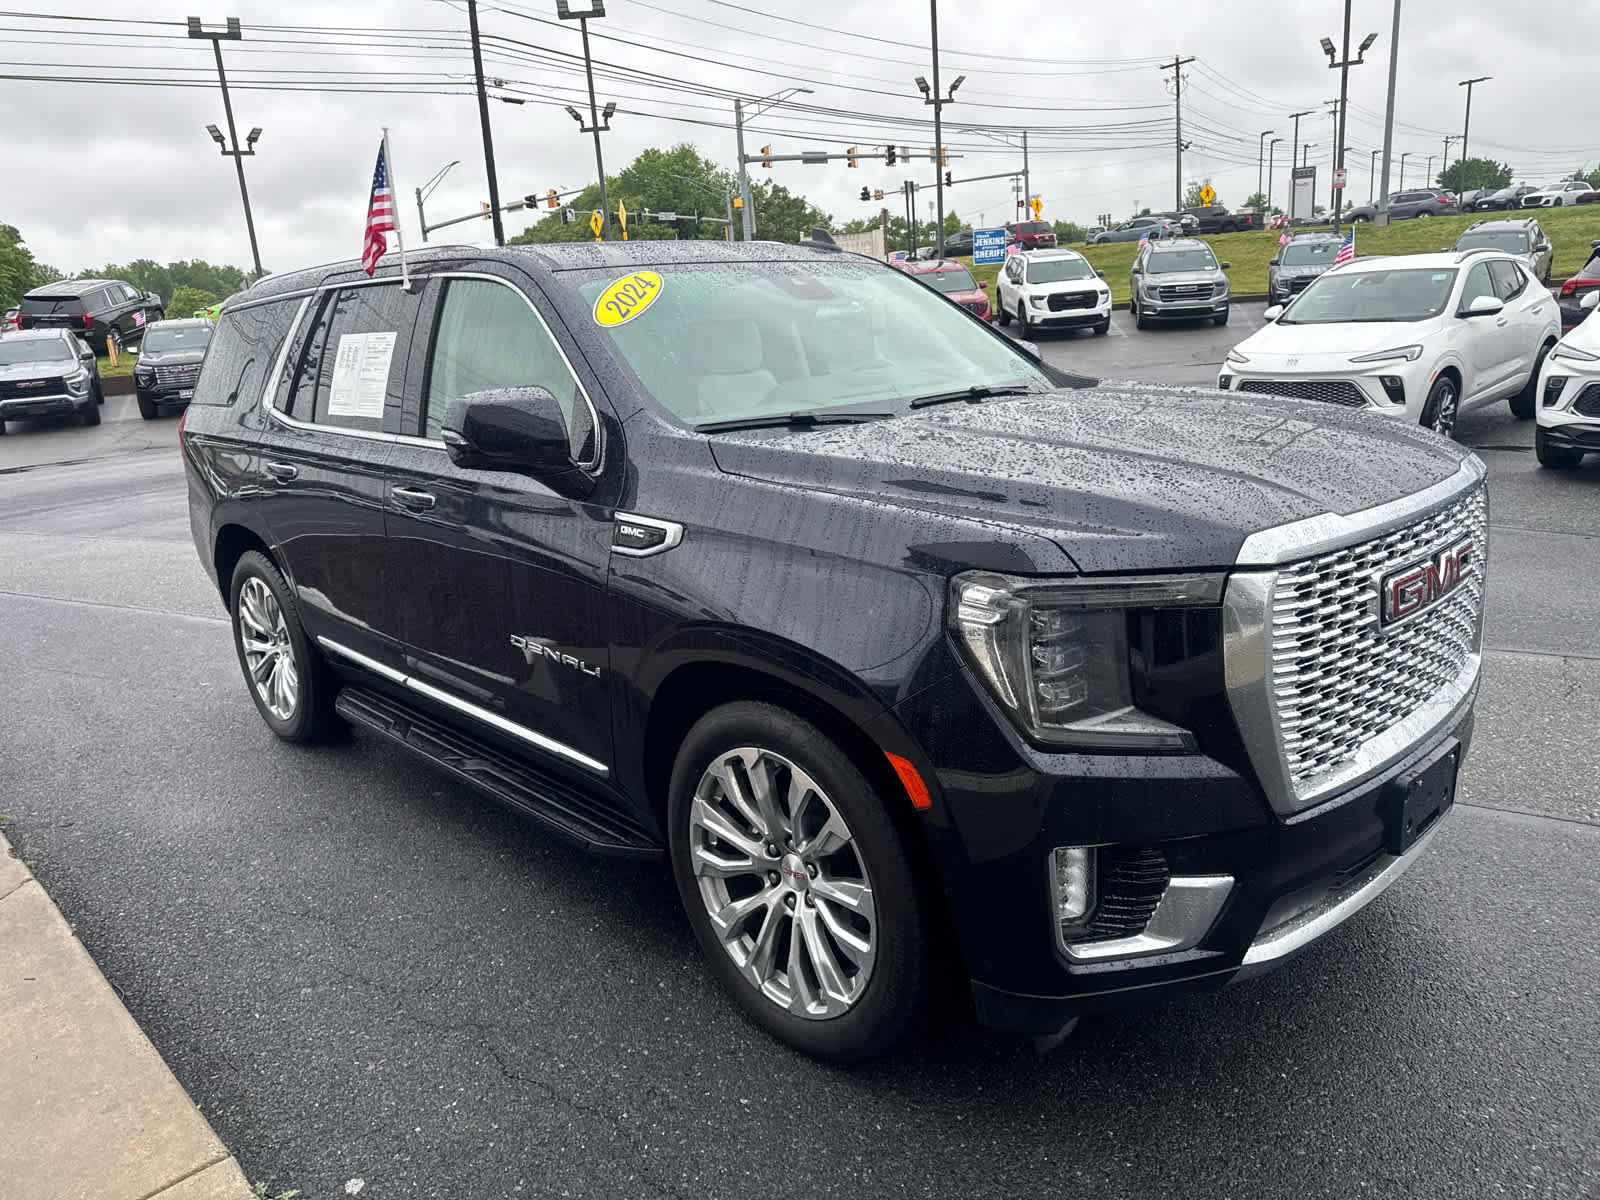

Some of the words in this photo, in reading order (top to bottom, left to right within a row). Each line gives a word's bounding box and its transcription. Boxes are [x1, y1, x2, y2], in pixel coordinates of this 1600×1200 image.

[976, 237, 1004, 246] JENKINS
[976, 249, 1004, 258] SHERIFF
[606, 276, 655, 318] 2024
[620, 526, 645, 538] GMC
[1388, 540, 1473, 617] GMC
[510, 634, 601, 679] DENALI
